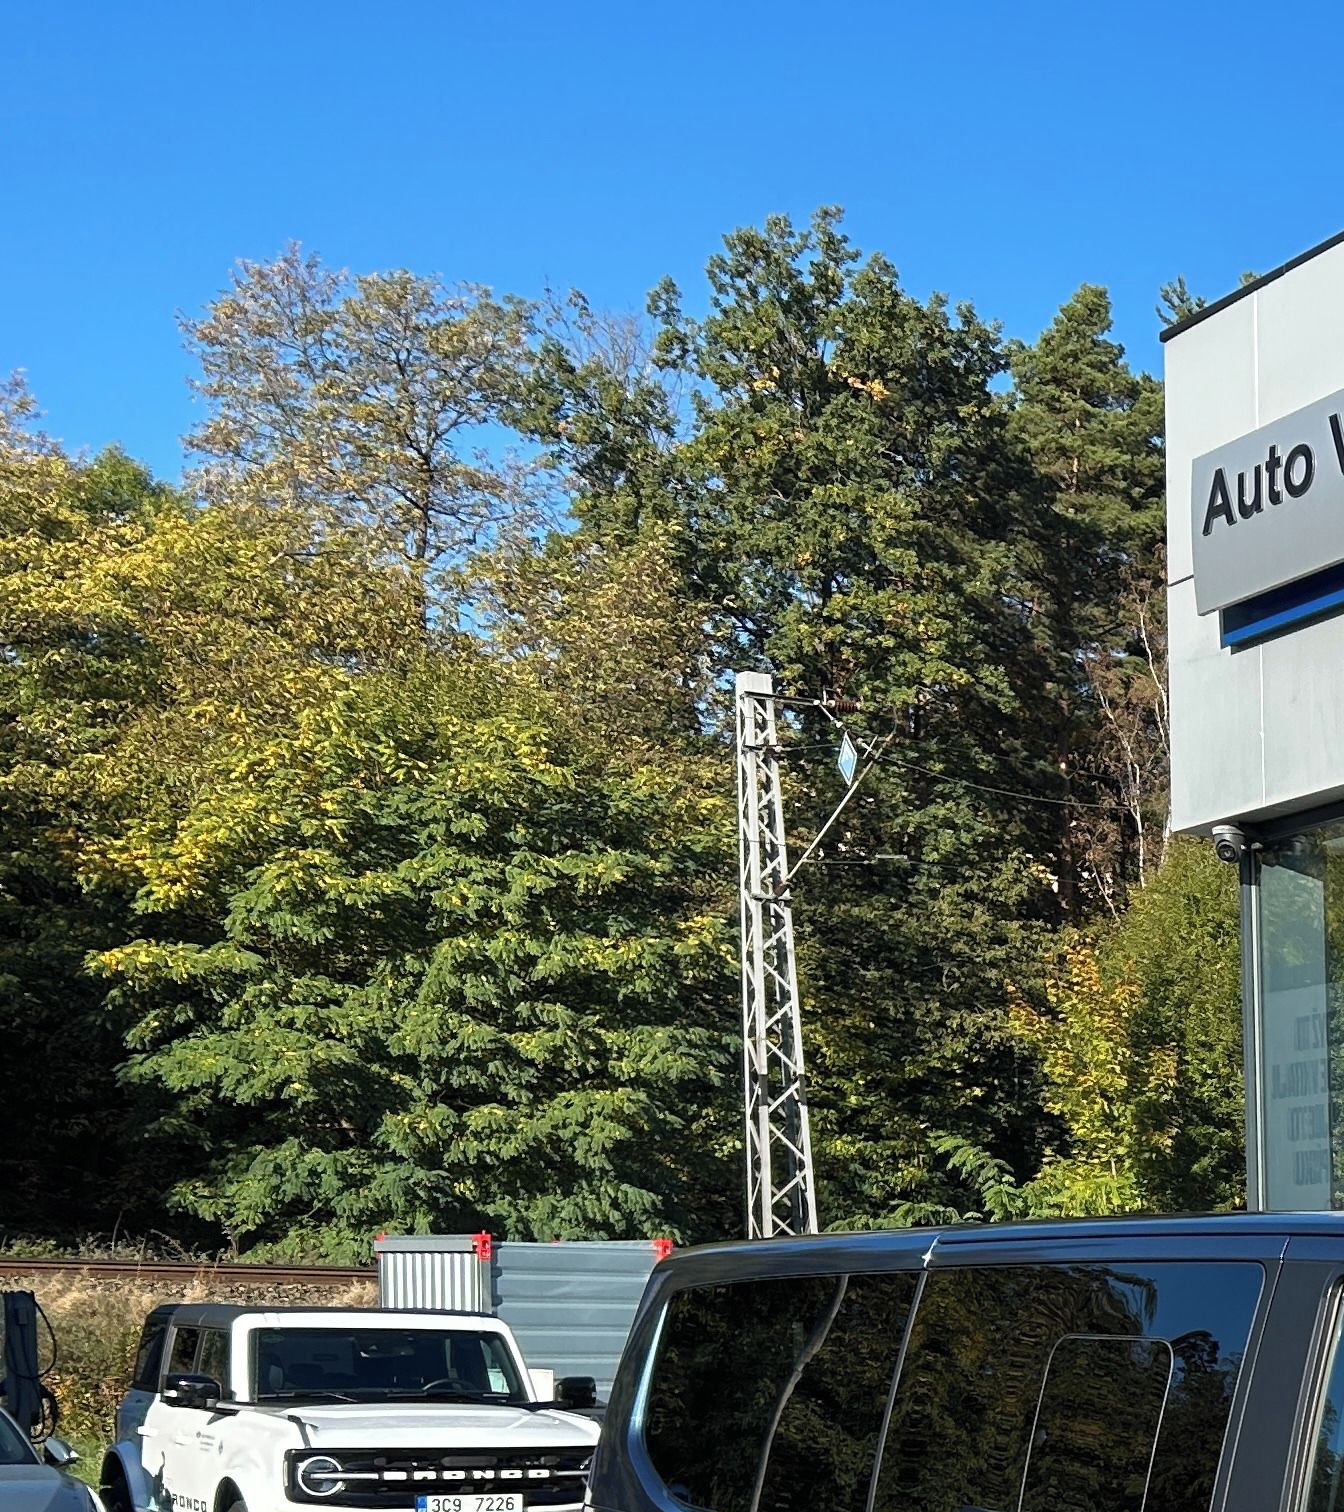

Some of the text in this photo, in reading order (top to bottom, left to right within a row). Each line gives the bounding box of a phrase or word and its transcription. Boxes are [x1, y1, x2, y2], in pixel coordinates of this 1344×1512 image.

[1202, 443, 1315, 536] Auto
[171, 1493, 207, 1512] RONCO
[431, 1498, 462, 1512] 3C9
[475, 1497, 515, 1512] 7226
